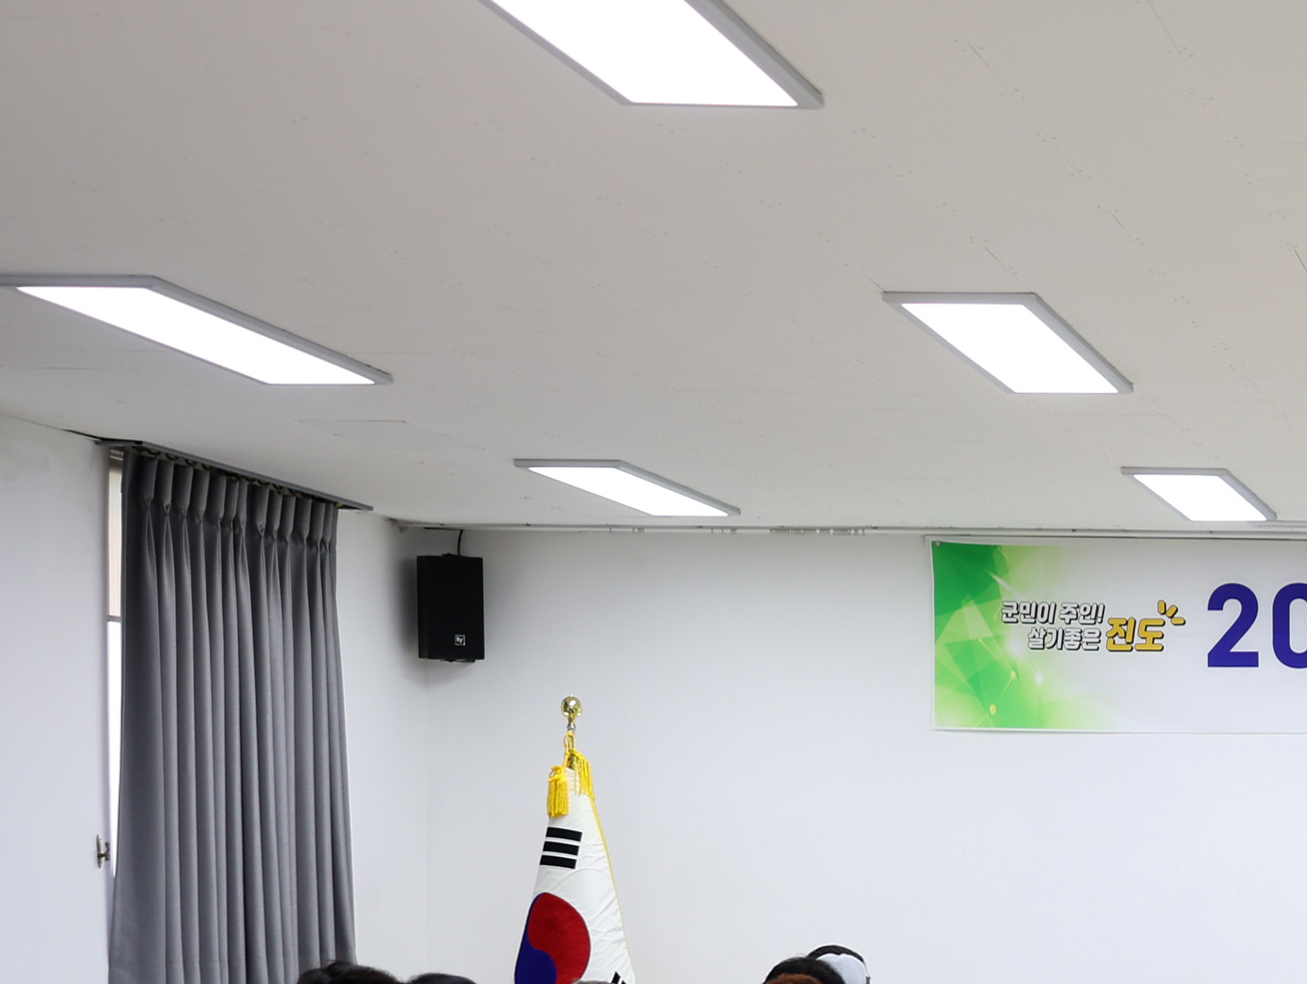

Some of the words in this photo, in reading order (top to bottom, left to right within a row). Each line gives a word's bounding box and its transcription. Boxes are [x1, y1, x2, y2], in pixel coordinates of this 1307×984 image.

[1001, 601, 1057, 624] 군민이
[1058, 602, 1105, 625] 주인!
[1027, 627, 1102, 651] 살기좋은
[1106, 617, 1166, 652] 진도
